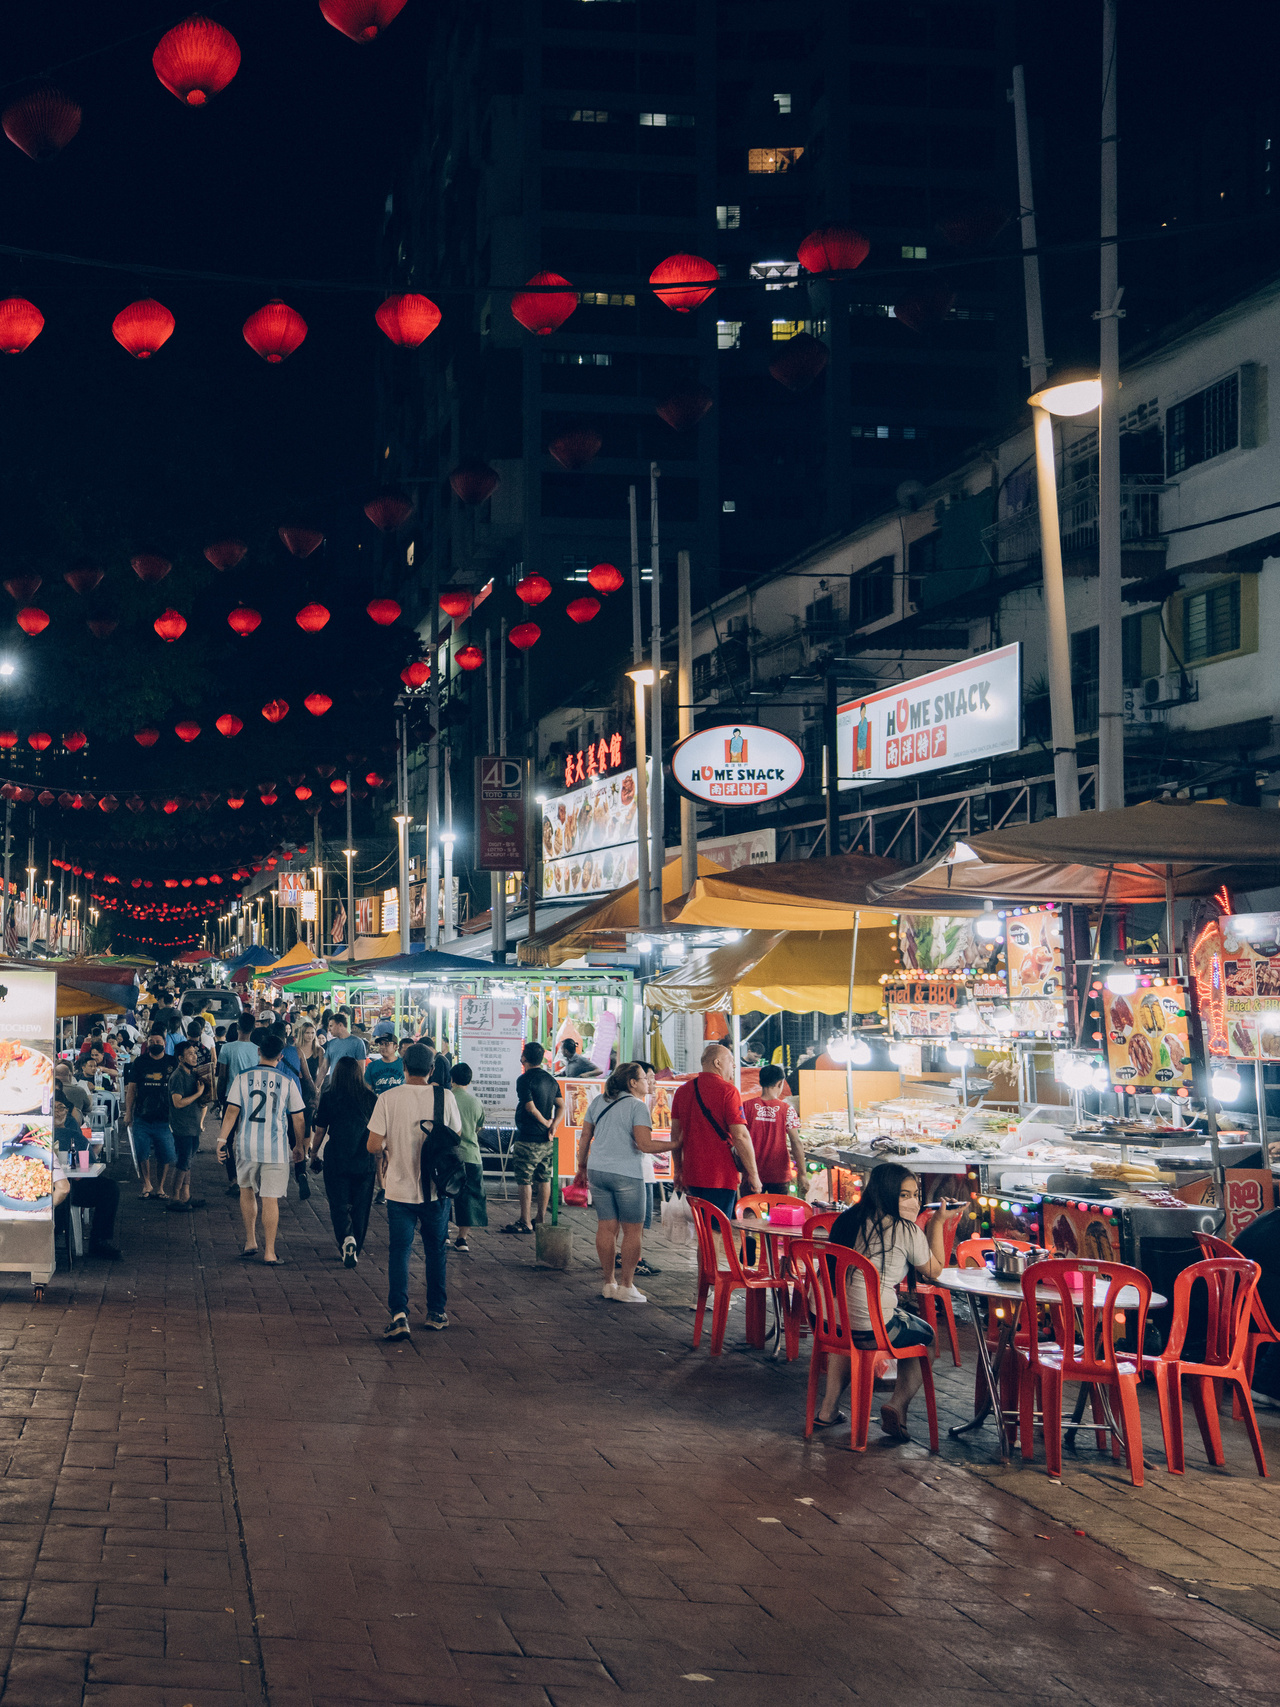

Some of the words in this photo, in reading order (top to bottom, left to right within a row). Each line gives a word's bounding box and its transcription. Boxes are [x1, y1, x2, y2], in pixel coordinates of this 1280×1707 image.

[887, 698, 931, 737] HOME
[933, 680, 991, 724] SNACK
[886, 725, 947, 769] 南洋特产
[482, 761, 521, 788] 4D
[691, 766, 734, 781] HOME
[737, 769, 785, 781] SNACK
[710, 783, 767, 796] 南洋特产
[281, 874, 305, 889] KK
[882, 982, 910, 1005] Fried
[914, 983, 925, 1004] &
[928, 983, 958, 1008] BBQ
[1227, 999, 1250, 1013] Fried
[1253, 999, 1261, 1013] &
[249, 1079, 281, 1089] JASON
